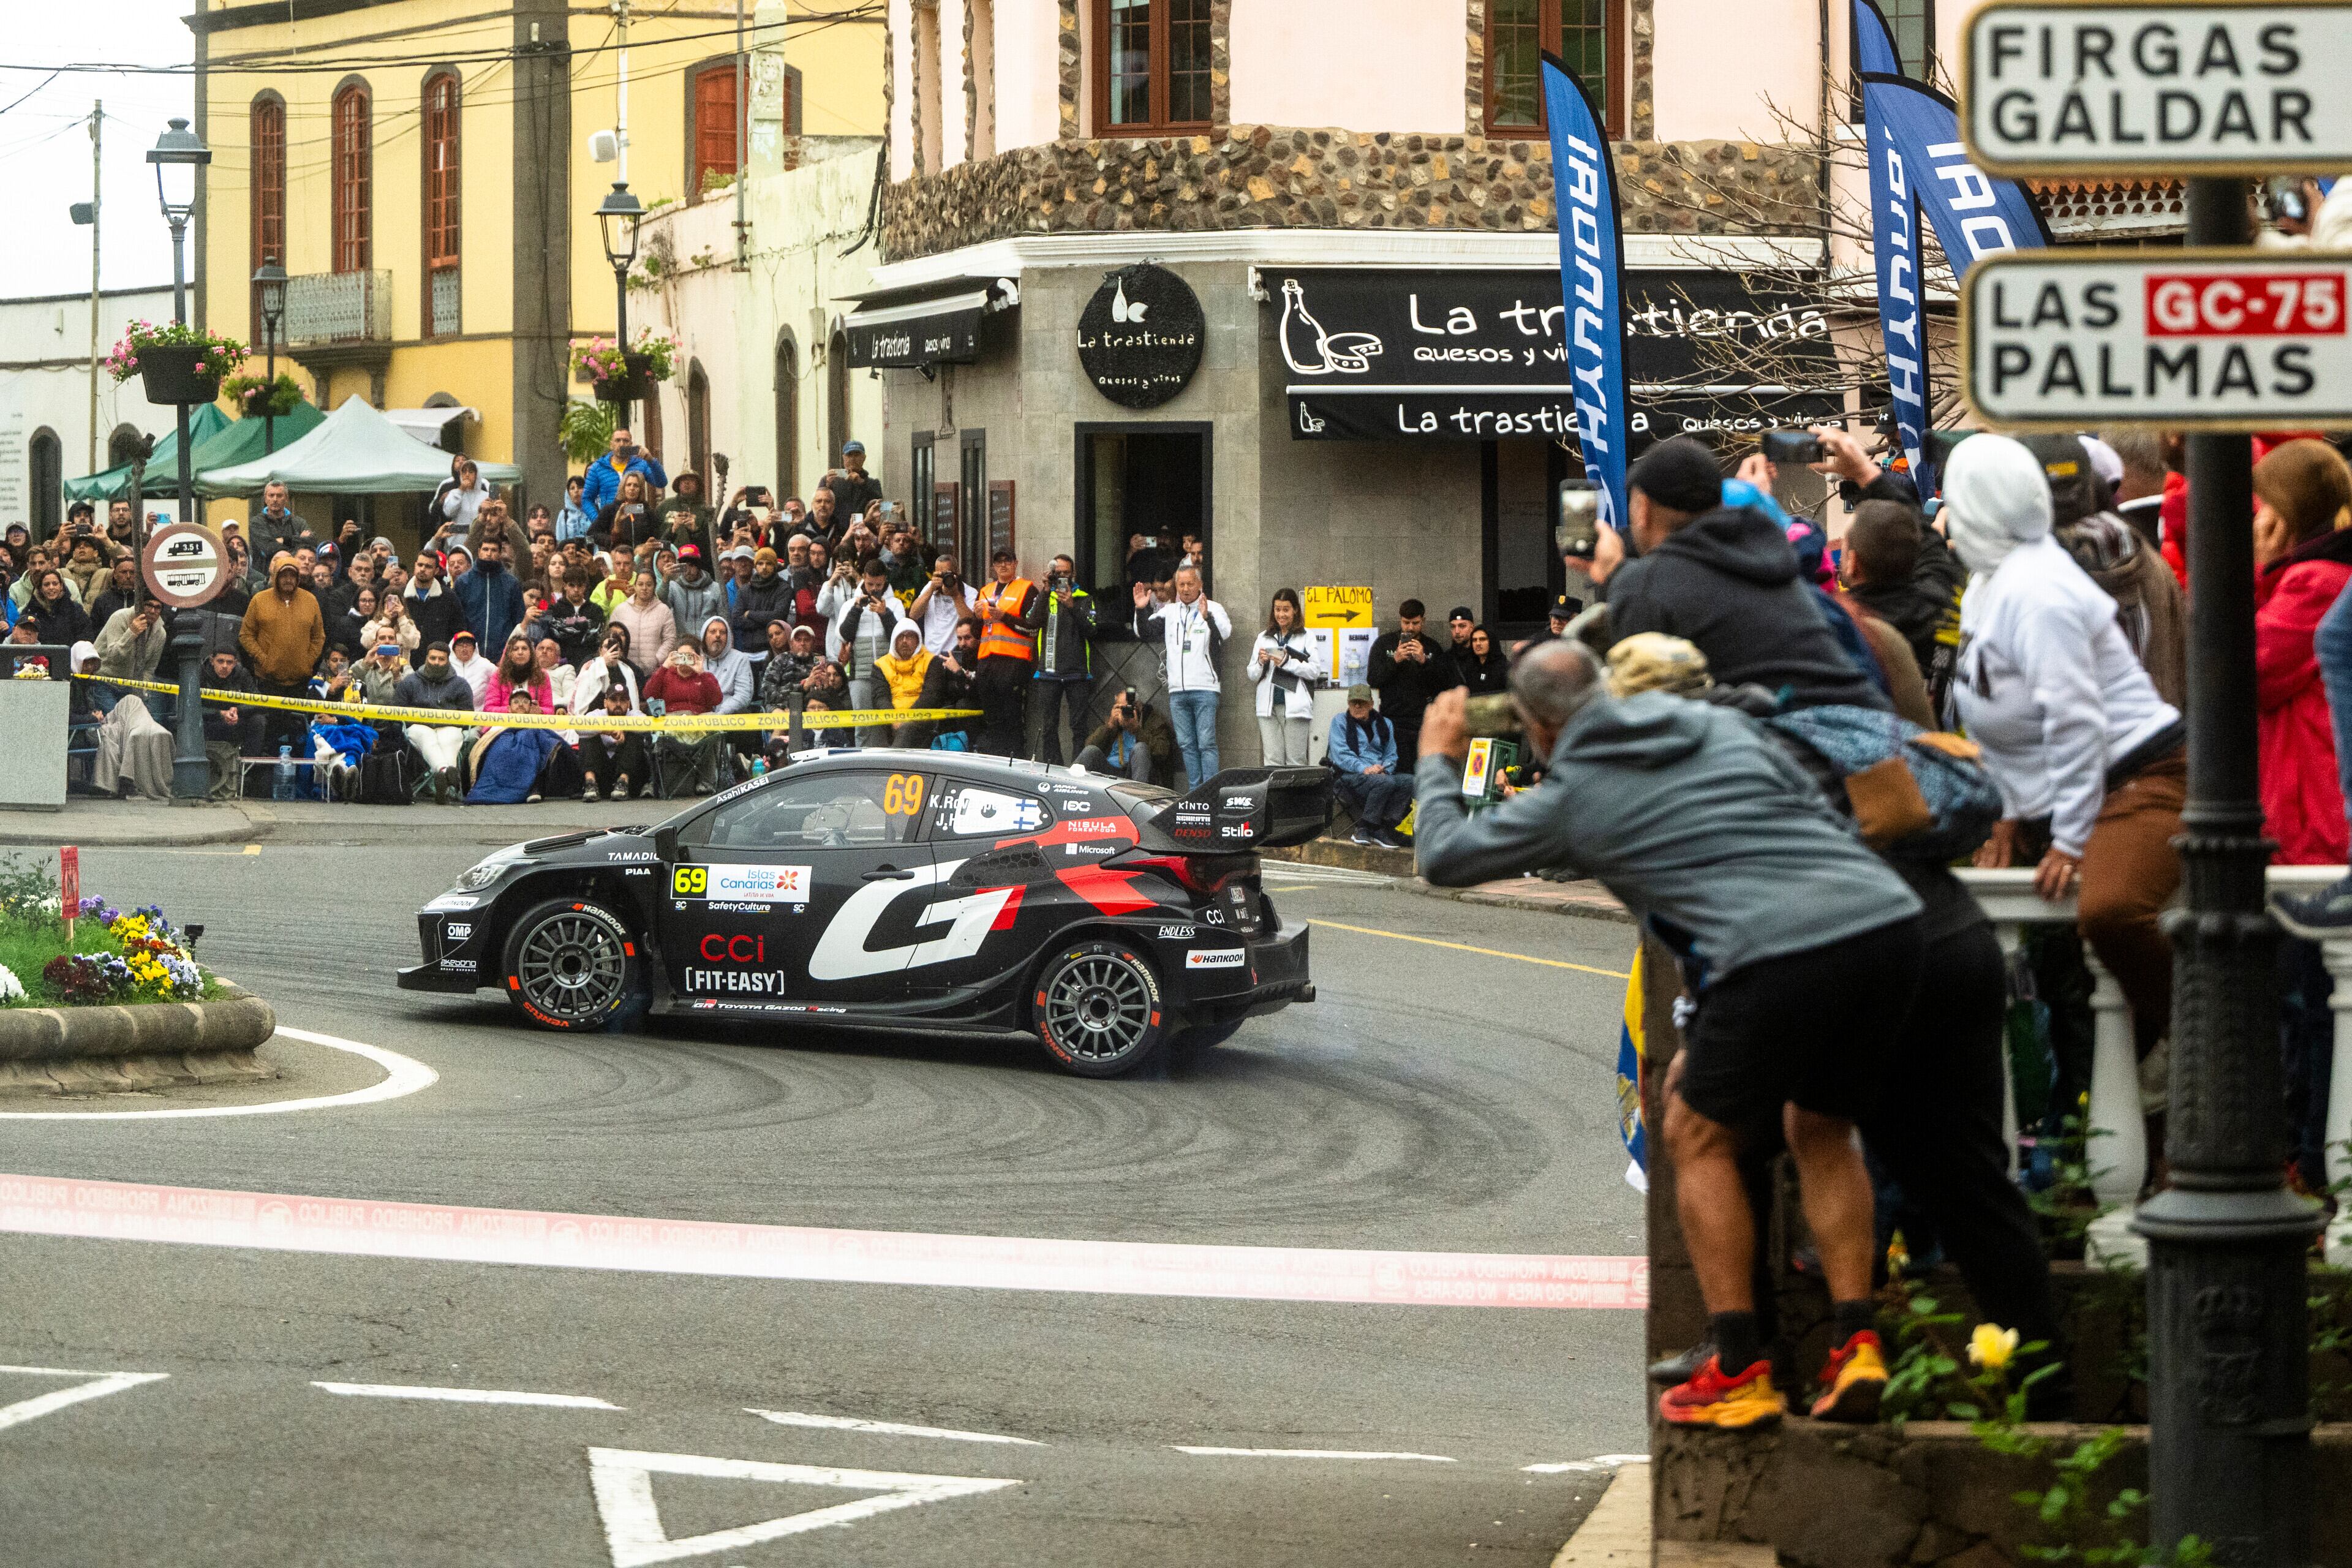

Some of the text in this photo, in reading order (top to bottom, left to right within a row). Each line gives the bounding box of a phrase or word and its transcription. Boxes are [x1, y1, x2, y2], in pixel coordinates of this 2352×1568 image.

[1989, 22, 2302, 79] FIRGAS
[1567, 134, 1609, 454] HYUNDAI
[1992, 279, 2340, 330] LAS GC-75
[1410, 294, 1828, 339] La trtienda
[1077, 330, 1194, 348] La trastienda
[872, 334, 878, 360] La
[1523, 347, 1535, 366] y
[1992, 342, 2315, 398] PALMAS
[1099, 374, 1181, 389] Quesos y vinos
[1398, 404, 1438, 432] La
[1450, 405, 1650, 434] trastiea
[1306, 587, 1373, 605] EL PALOMO
[219, 689, 270, 704] PUBLICO
[280, 696, 366, 714] ZONA PUBLICO
[377, 707, 461, 721] ZONA PUBLICO
[473, 714, 556, 726] ZONA PUBLICO
[757, 716, 790, 726] ZONA
[568, 717, 652, 727] ZONA PUBLICO
[663, 717, 746, 727] ZONA PUBLICO
[883, 774, 924, 815] 69
[1174, 828, 1212, 838] DENSO
[1221, 823, 1254, 837] Stilo
[1079, 845, 1115, 854] Microsoft
[674, 867, 775, 893] 69 Islas
[720, 878, 775, 890] Canarias
[675, 900, 805, 913] SC SafetyCulture SC
[448, 925, 472, 937] OMP
[1158, 925, 1196, 937] ENDLESS
[807, 1005, 846, 1014] Racing
